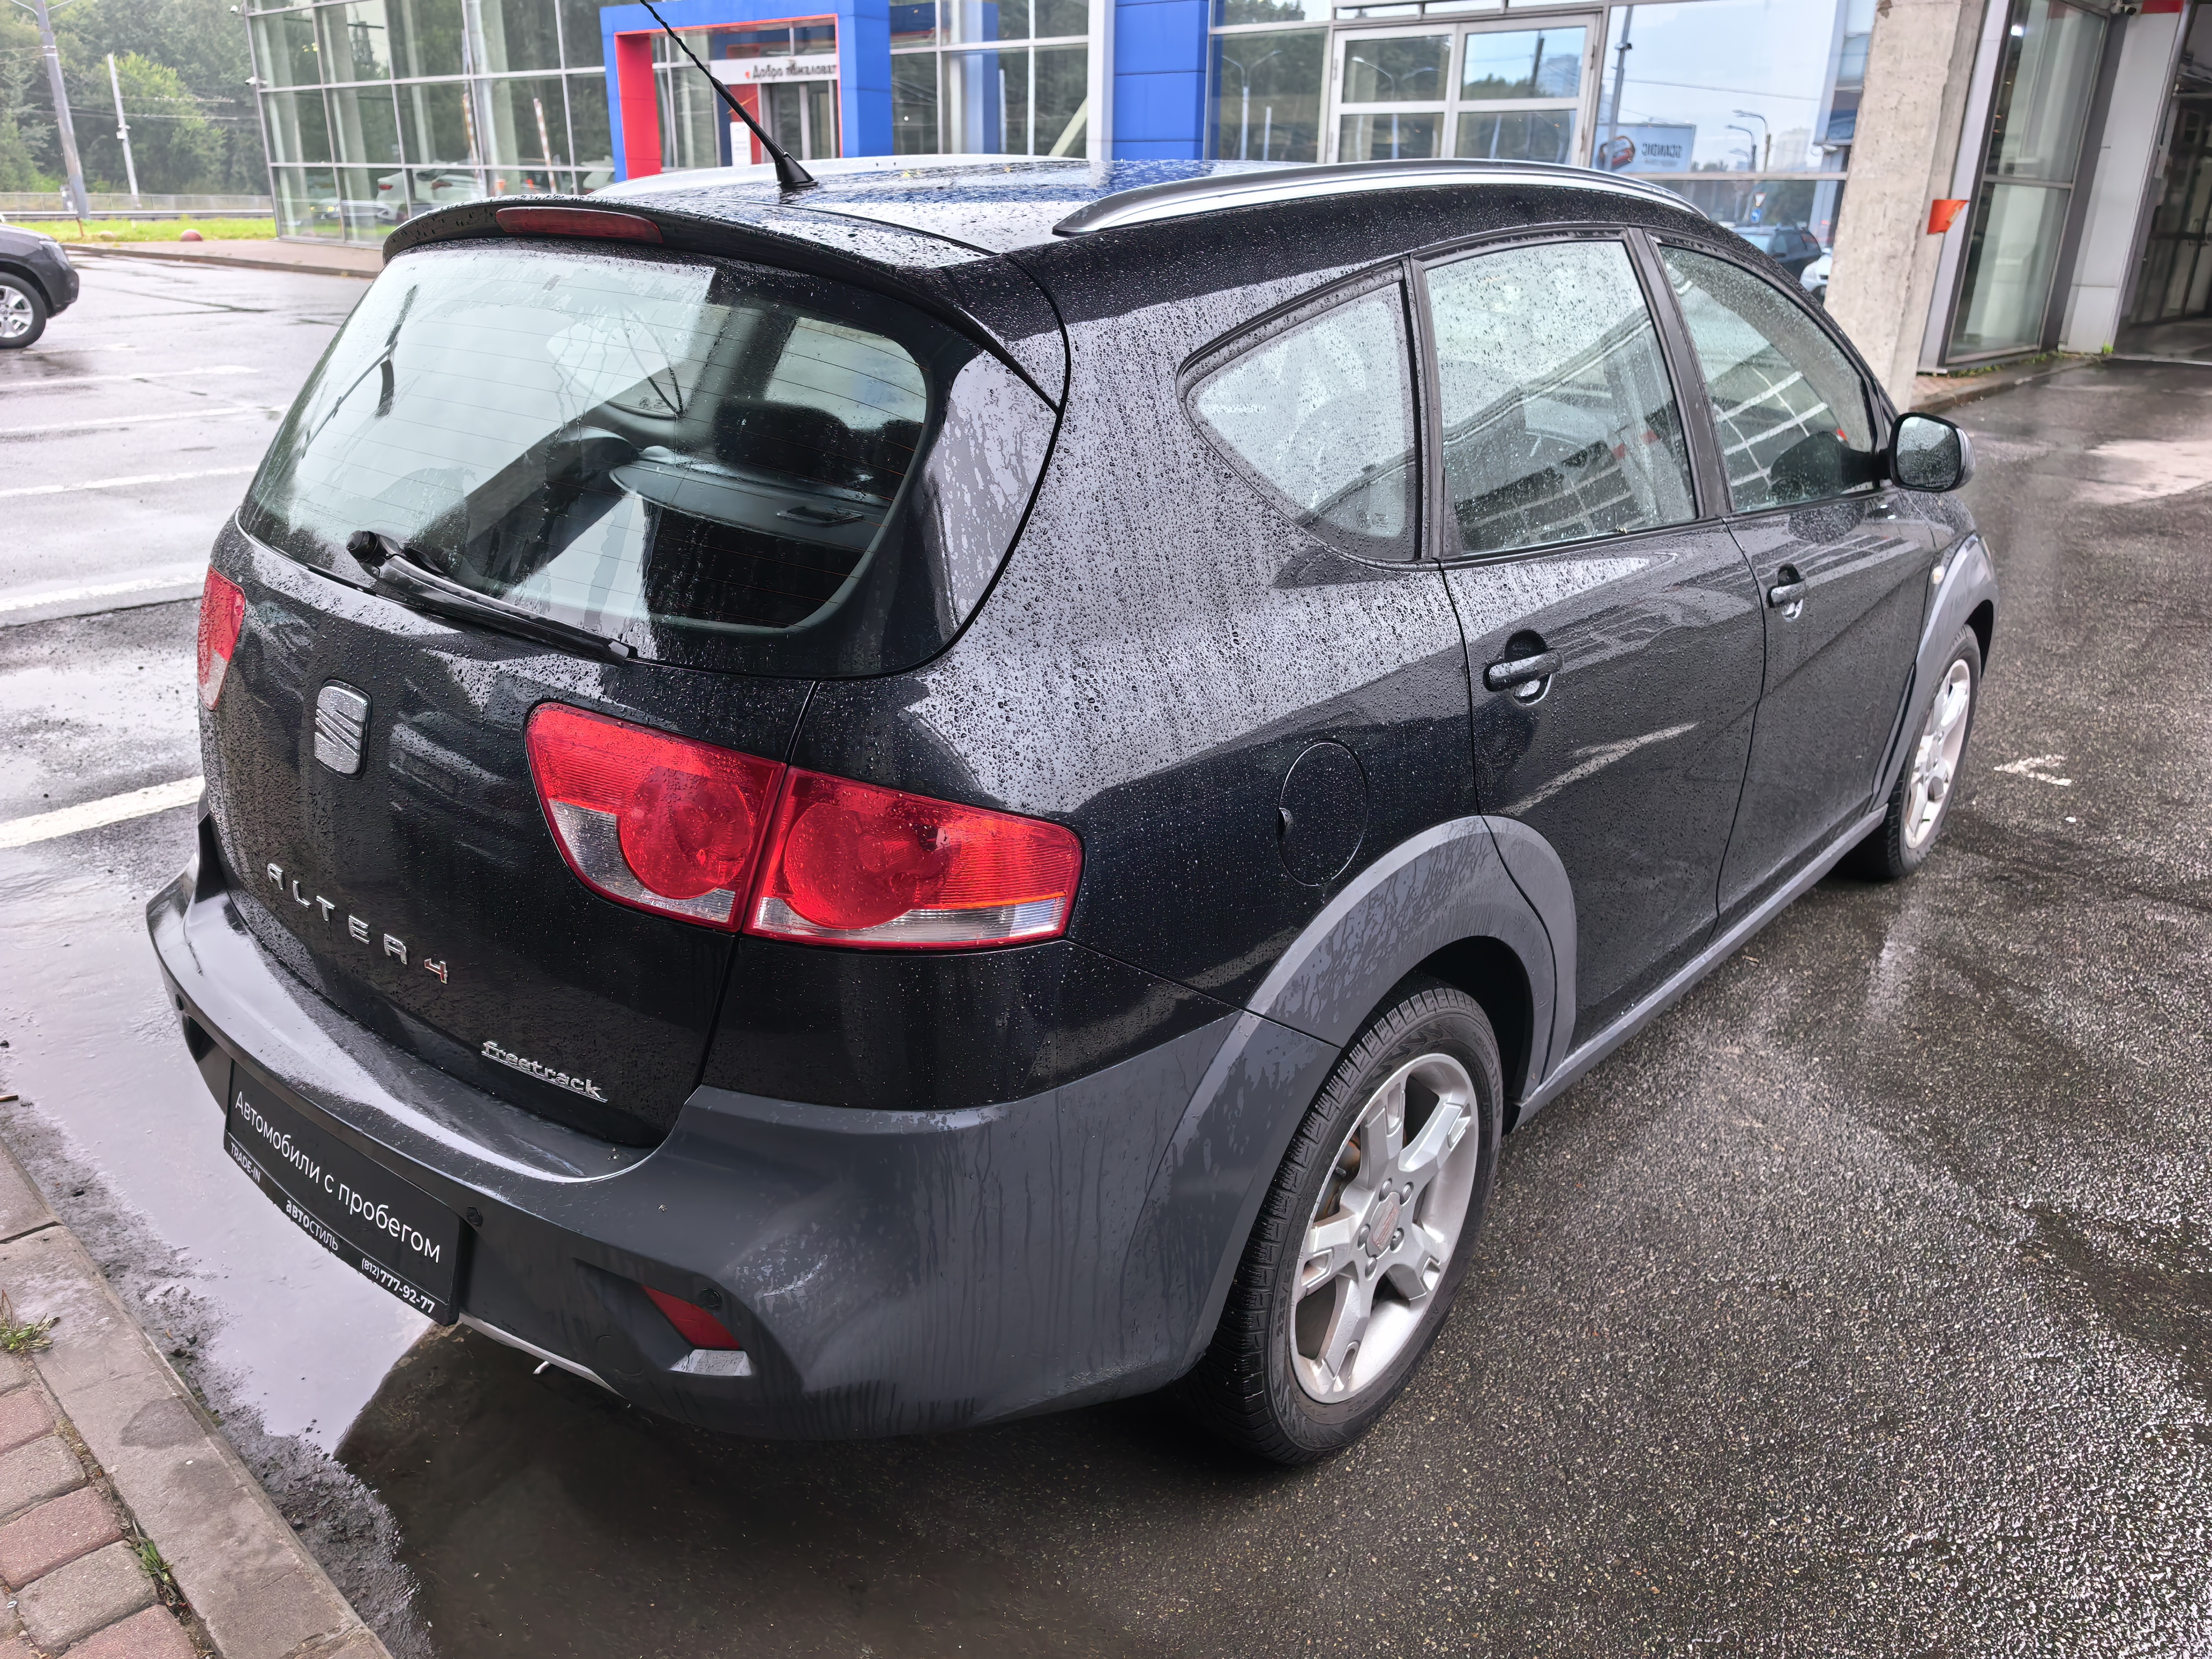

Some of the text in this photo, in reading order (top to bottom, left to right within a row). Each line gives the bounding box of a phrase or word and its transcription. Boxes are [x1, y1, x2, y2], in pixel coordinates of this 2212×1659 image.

[230, 1142, 261, 1184] TRADE-IN
[234, 1090, 441, 1263] Автомобили с пробегом
